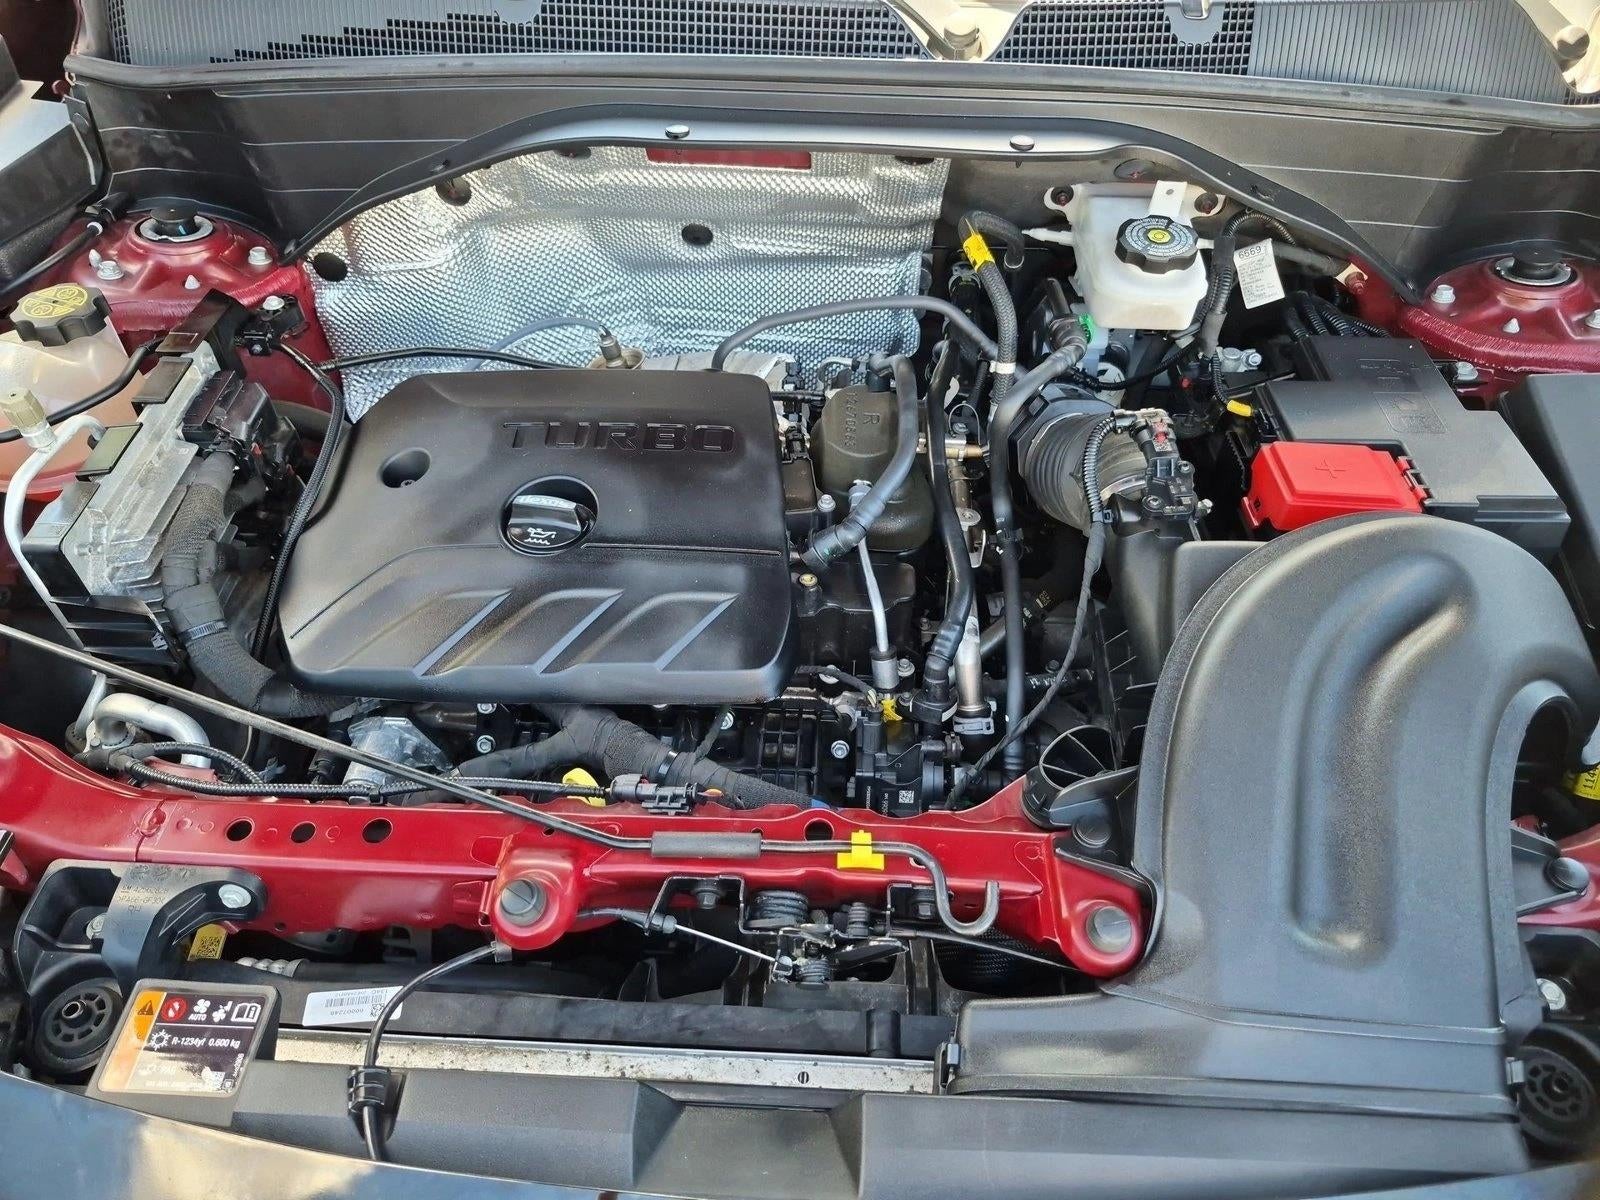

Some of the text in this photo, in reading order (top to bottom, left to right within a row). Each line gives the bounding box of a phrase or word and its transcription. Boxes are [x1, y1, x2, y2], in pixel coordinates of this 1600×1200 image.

[503, 422, 736, 452] TURBO
[171, 1036, 207, 1048] R-1234yf
[230, 1038, 241, 1049] kg
